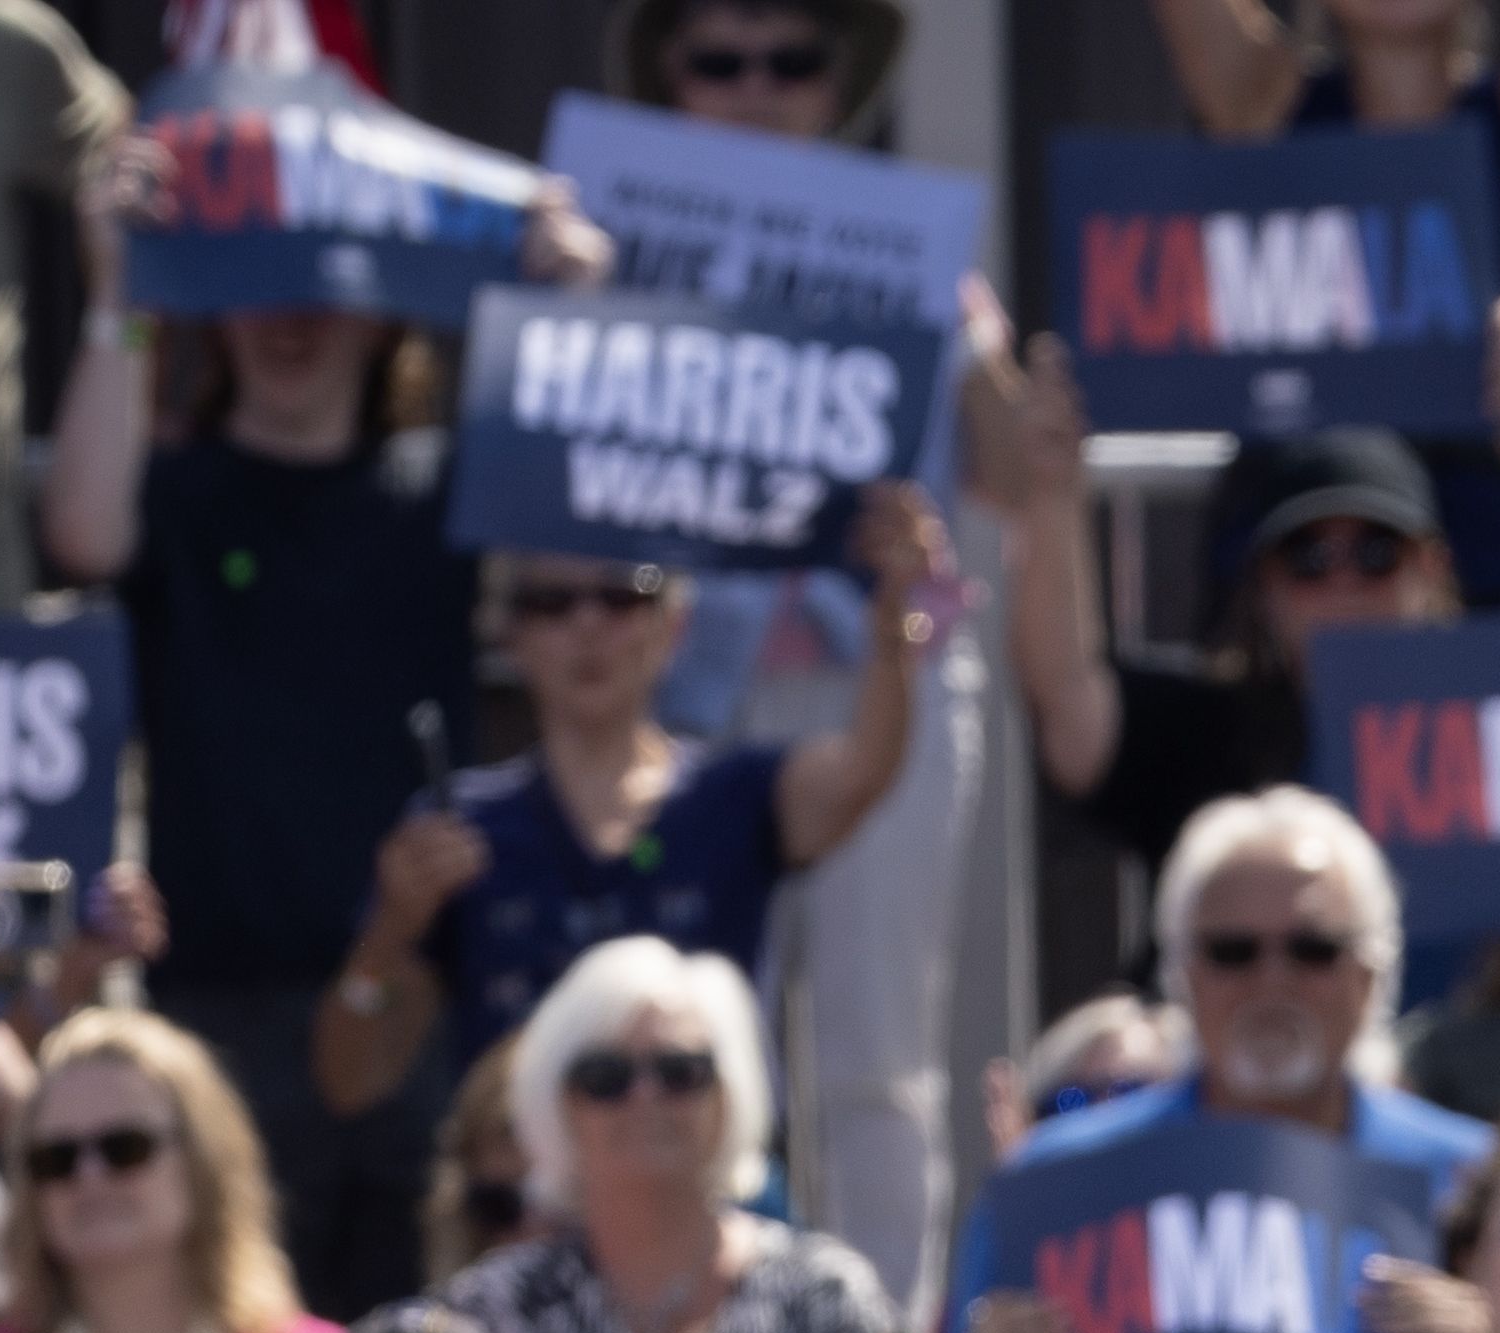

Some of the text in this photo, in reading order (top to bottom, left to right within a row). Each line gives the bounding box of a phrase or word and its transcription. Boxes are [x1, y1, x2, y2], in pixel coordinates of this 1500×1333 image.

[1079, 205, 1476, 356] KAMALA
[508, 313, 902, 486] HARRIS
[564, 438, 832, 548] WALZ
